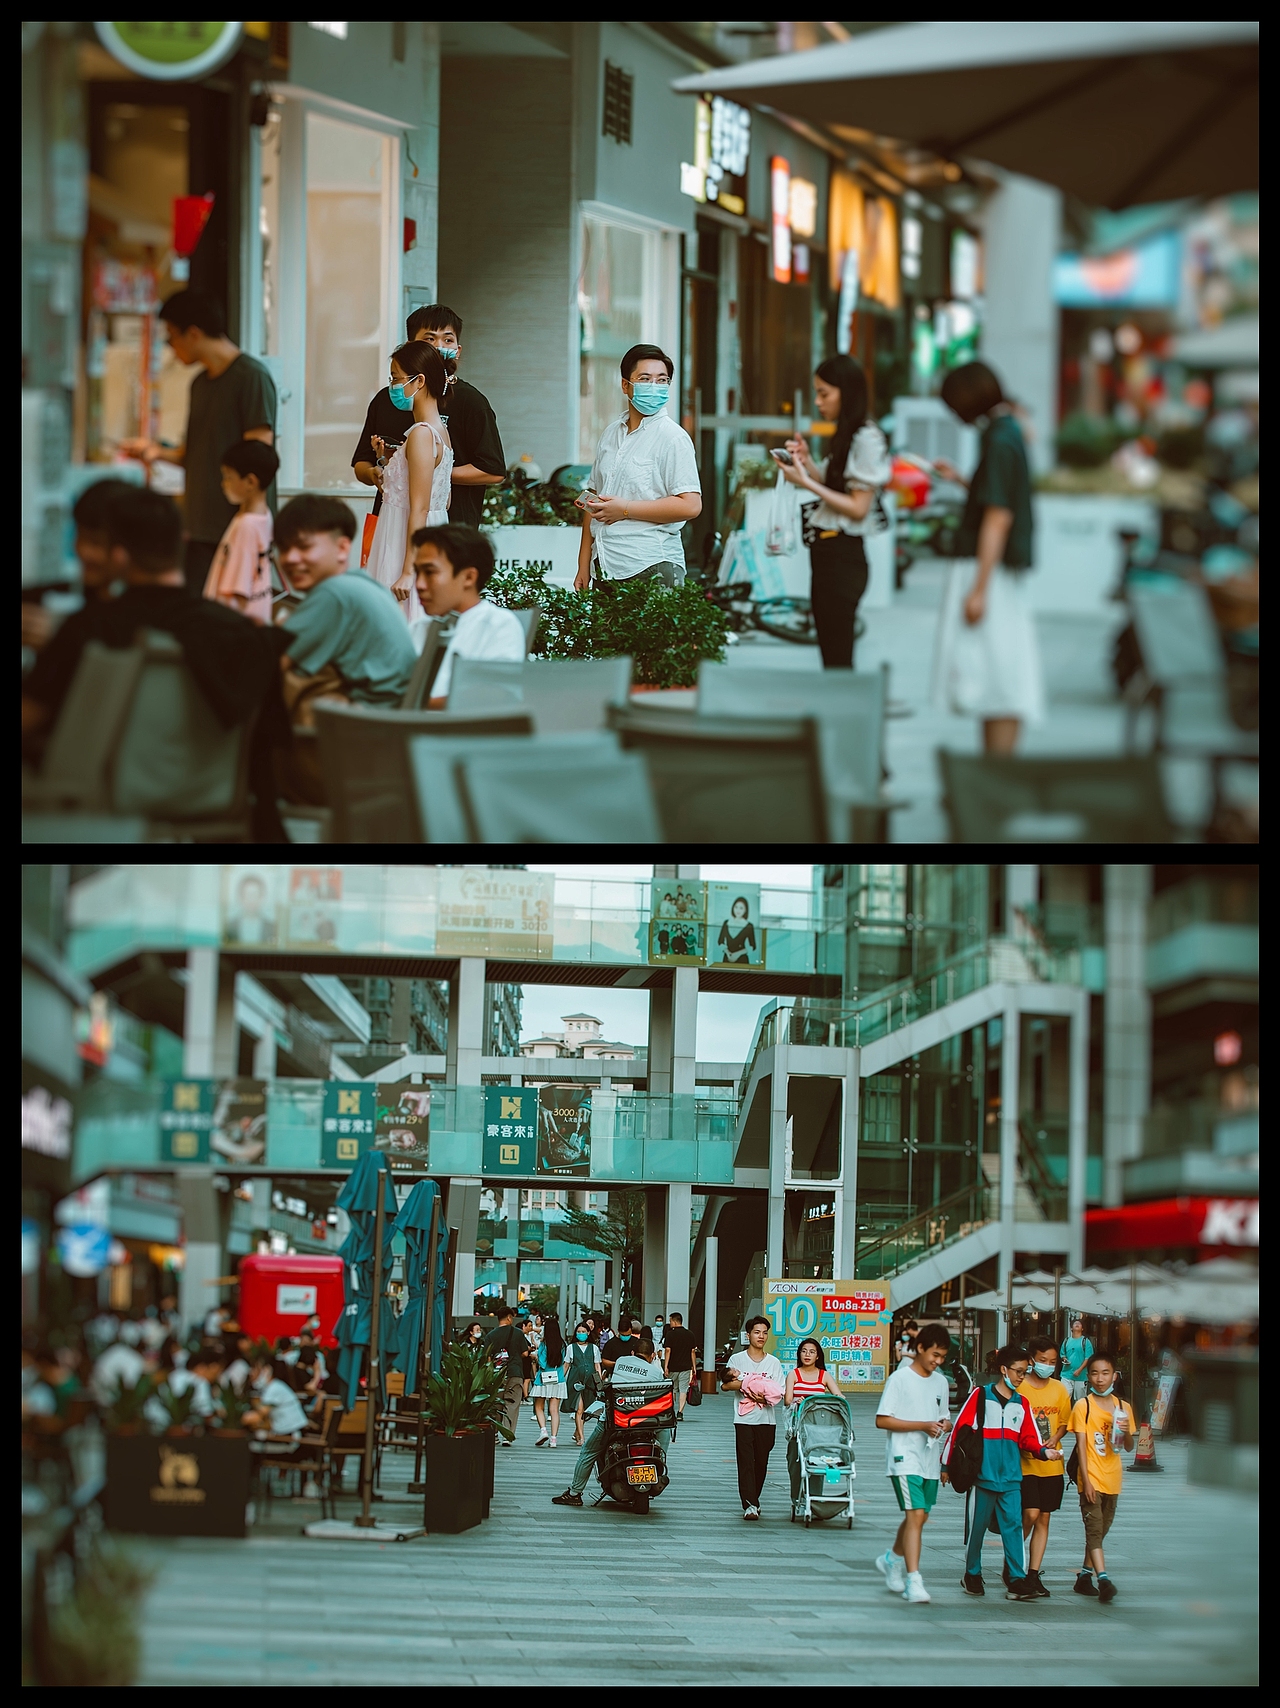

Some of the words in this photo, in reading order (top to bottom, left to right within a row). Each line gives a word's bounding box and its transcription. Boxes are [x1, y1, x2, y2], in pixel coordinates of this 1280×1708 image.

[522, 899, 549, 921] L3
[521, 921, 548, 931] 3020
[553, 1108, 575, 1117] 3000
[340, 1142, 354, 1155] L1
[502, 1148, 517, 1160] L1
[820, 1336, 882, 1349] 永旺1楼2楼
[830, 1350, 872, 1361] 同时销售
